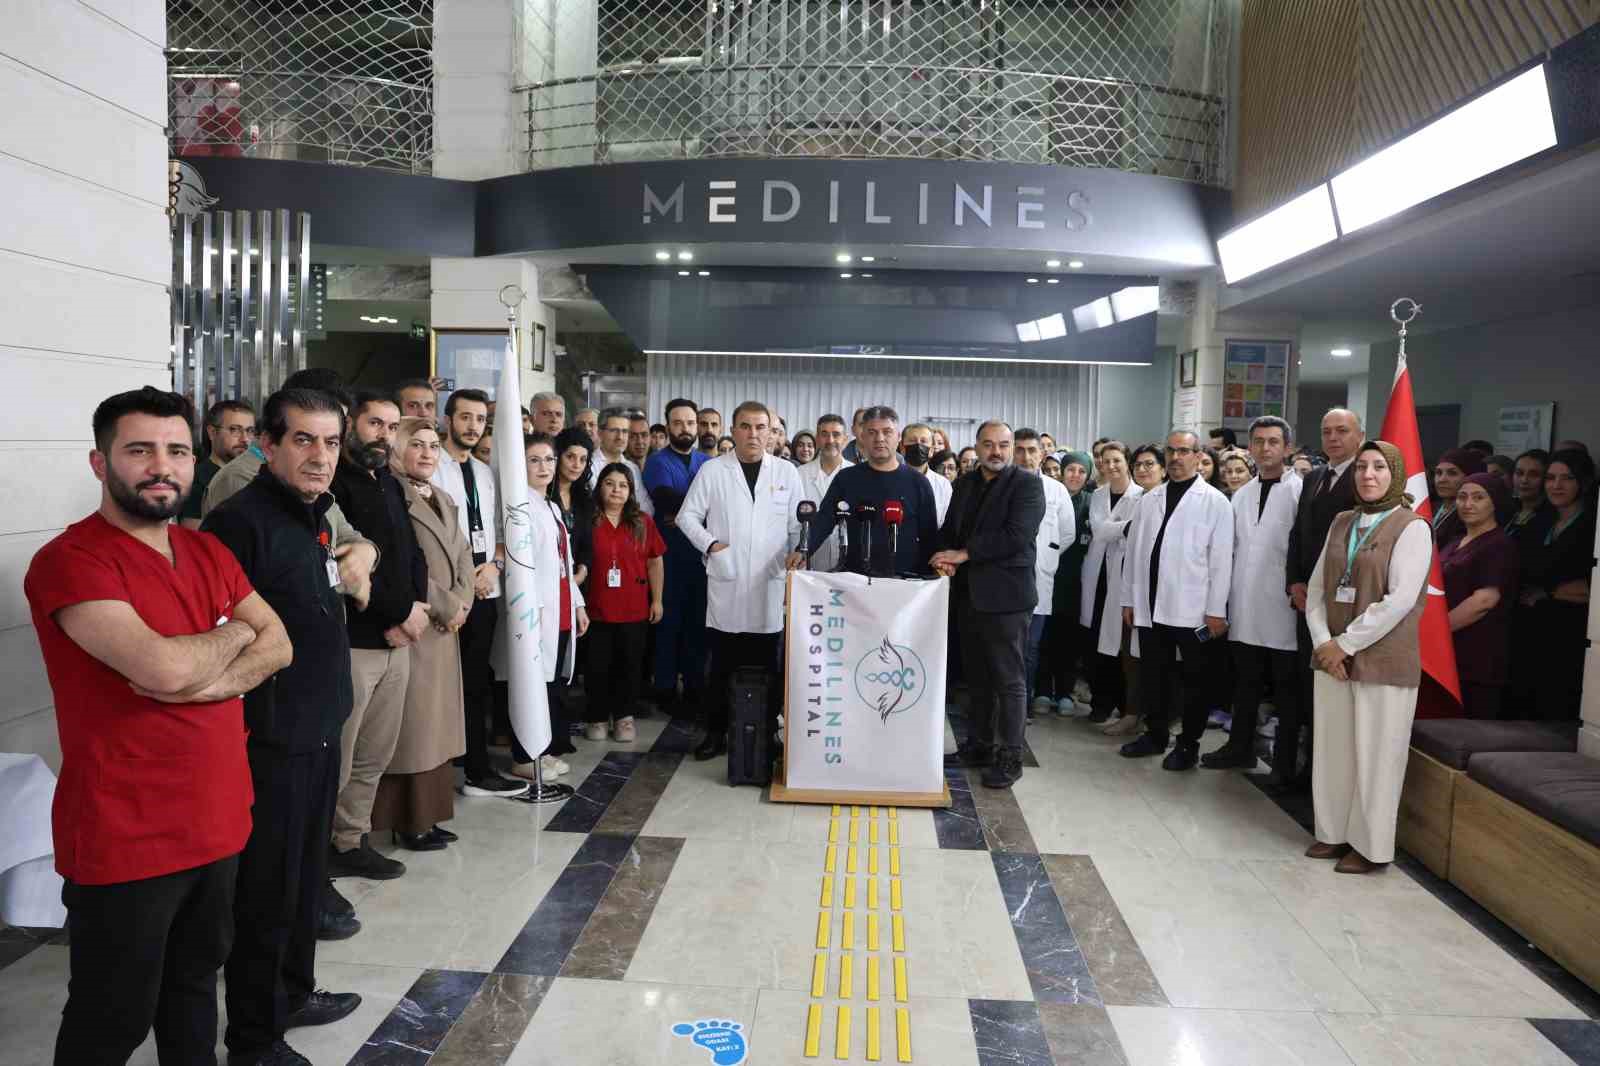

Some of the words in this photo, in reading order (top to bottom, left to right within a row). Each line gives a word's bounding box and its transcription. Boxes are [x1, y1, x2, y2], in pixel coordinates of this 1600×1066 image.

[642, 179, 1094, 233] MEDILINES
[806, 604, 824, 738] HOSPITAL
[824, 588, 846, 765] MEDILINES
